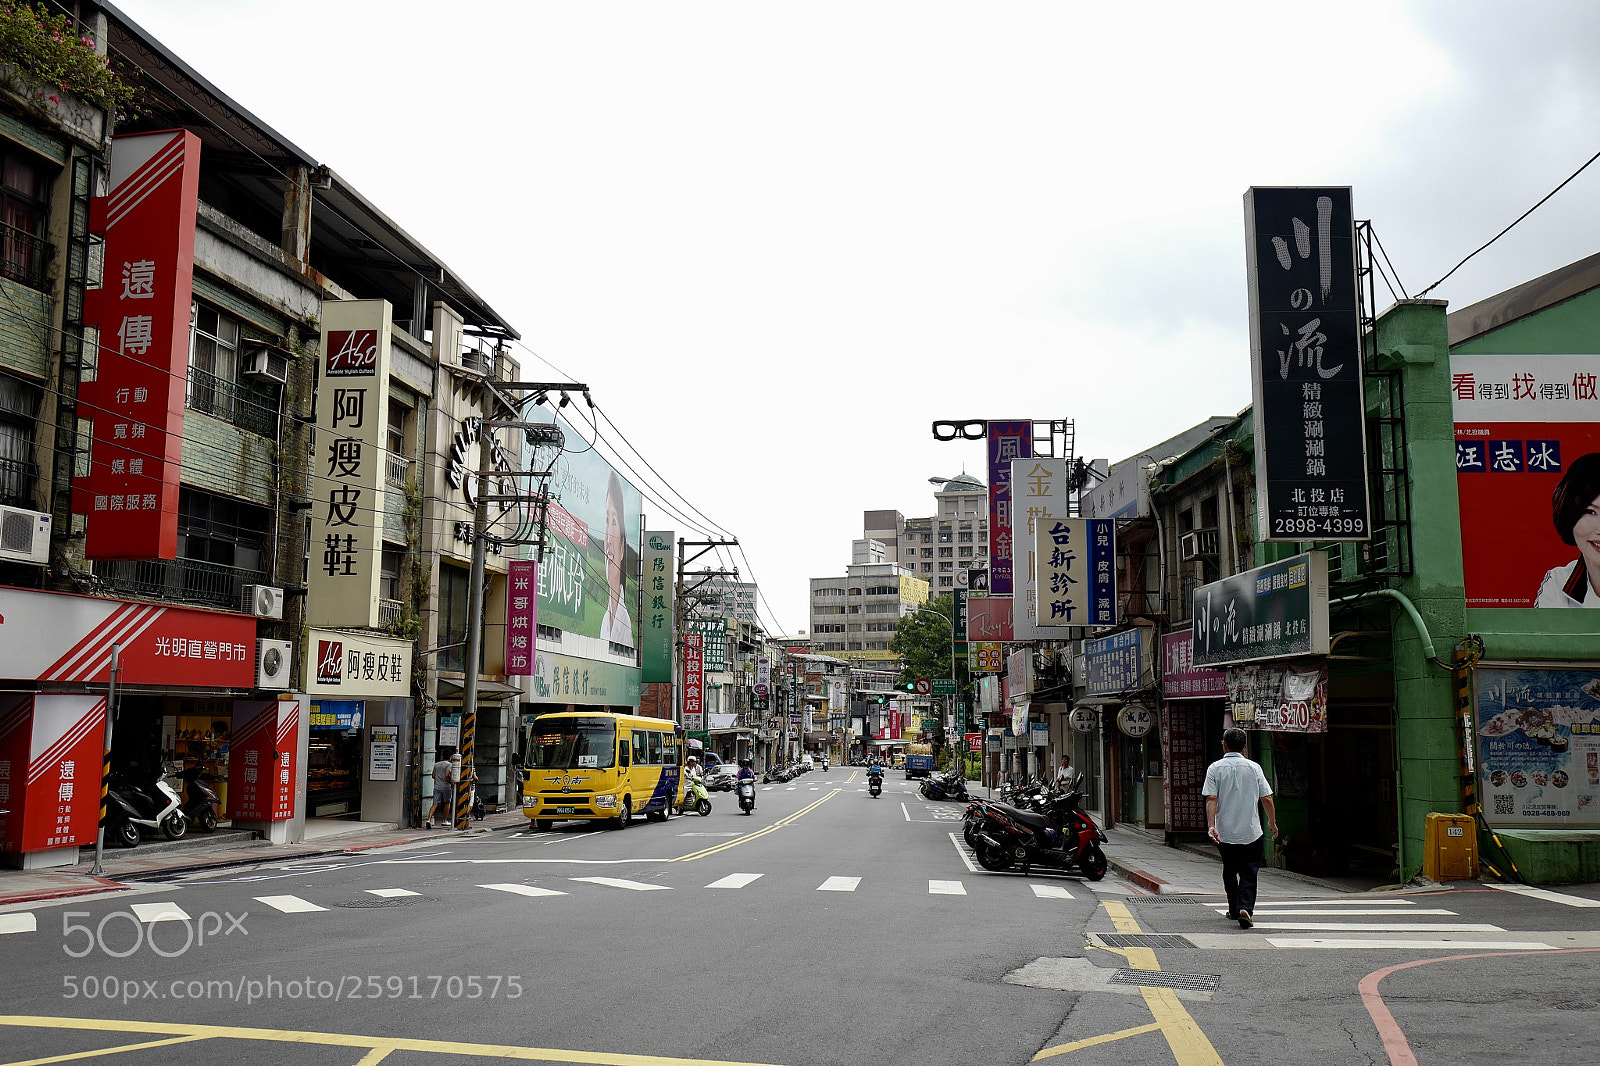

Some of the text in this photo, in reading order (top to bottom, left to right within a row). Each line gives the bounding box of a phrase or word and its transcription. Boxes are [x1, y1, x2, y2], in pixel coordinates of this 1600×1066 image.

[1271, 196, 1344, 380] 川の流
[117, 259, 156, 356] 遠傳
[116, 387, 149, 404] 行動
[114, 423, 146, 440] 寬頻
[1302, 382, 1326, 477] 精緻涮涮鍋
[111, 458, 144, 475] 媒體
[1455, 441, 1560, 472] 汪志冰
[322, 387, 368, 577] 阿瘦皮鞋
[1291, 488, 1345, 503] 北投店
[94, 494, 157, 511] 國際服務
[1298, 506, 1340, 517] 訂位專線
[1275, 519, 1363, 533] 2898-4399
[1047, 521, 1078, 623] 台新診所
[652, 557, 667, 629] 陽信銀行
[511, 577, 529, 668] 米哥烘焙坊
[1197, 591, 1240, 657] 川の流
[1242, 618, 1307, 645] 精緻涮涮鍋 北投店
[155, 636, 246, 662] 光明直營門市
[347, 650, 402, 683] 阿瘦皮鞋
[552, 666, 589, 696] 陽信銀行
[685, 635, 700, 711] 新北投飲食店
[1125, 711, 1149, 723] 減肥
[58, 760, 75, 803] 遠傳
[244, 749, 259, 784] 遠傳
[280, 752, 290, 795] 遠傳
